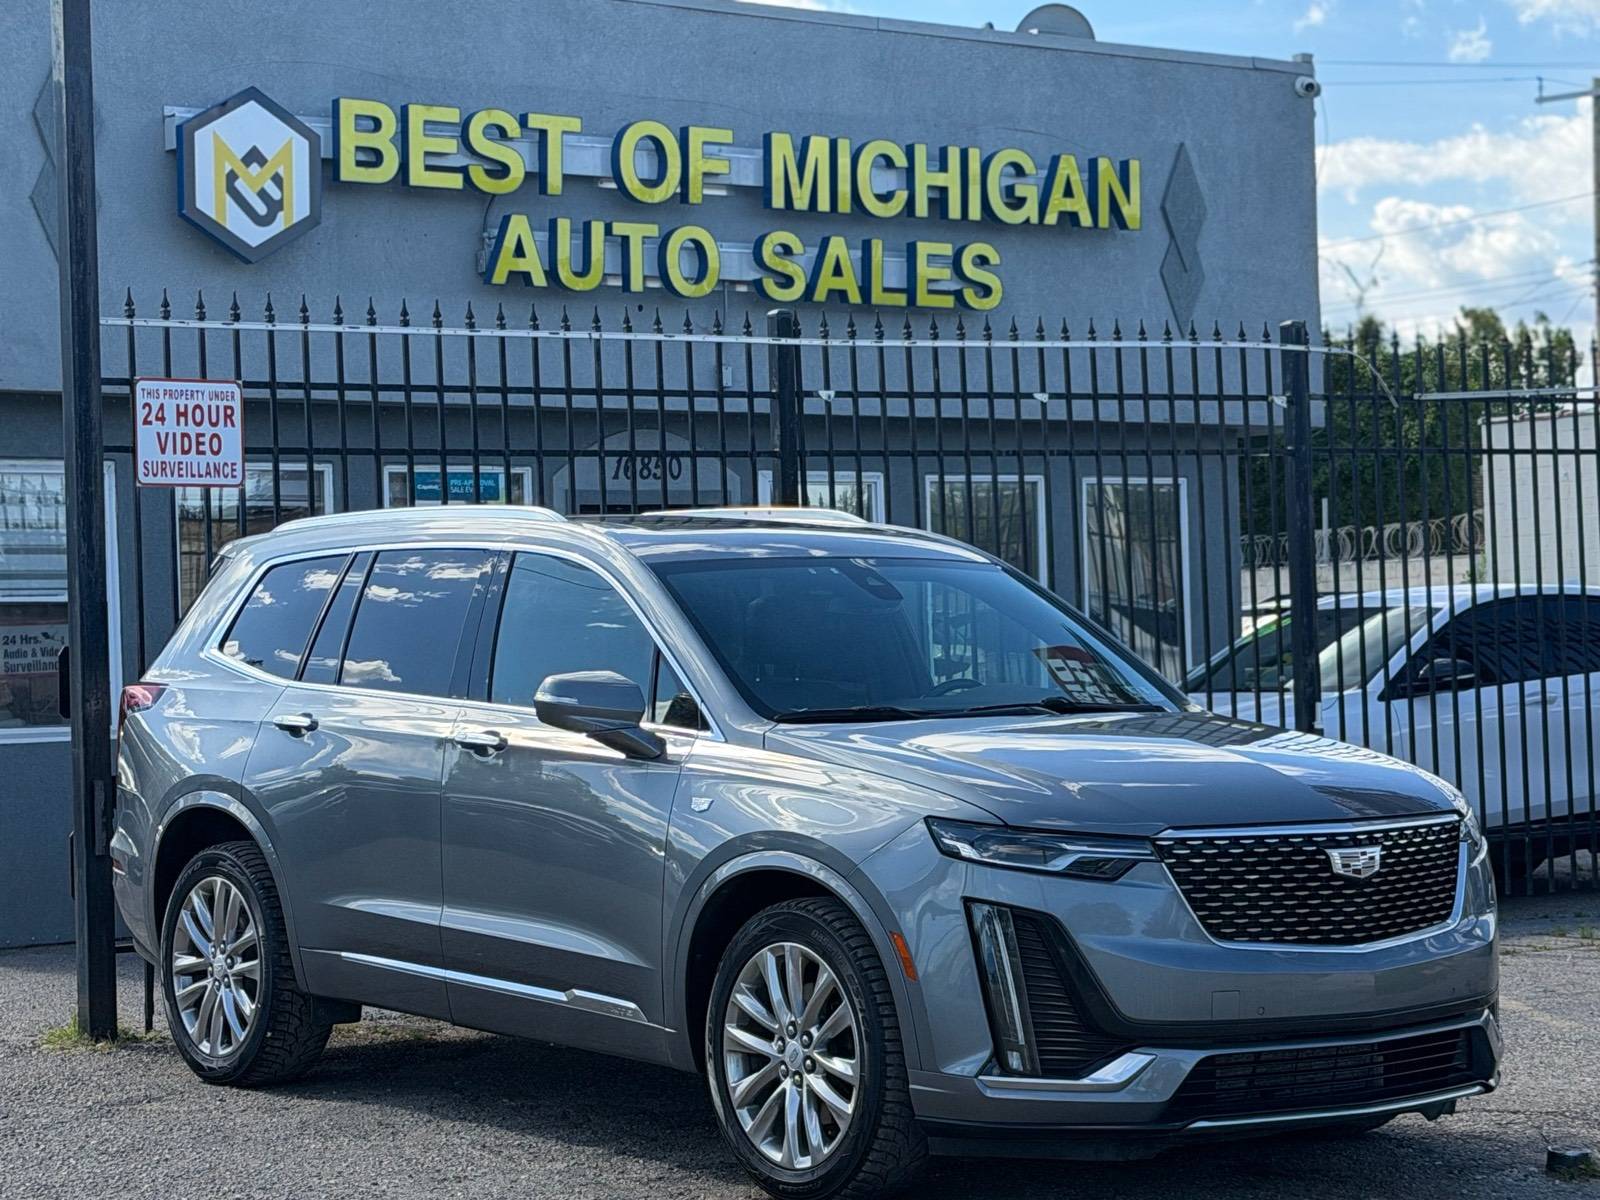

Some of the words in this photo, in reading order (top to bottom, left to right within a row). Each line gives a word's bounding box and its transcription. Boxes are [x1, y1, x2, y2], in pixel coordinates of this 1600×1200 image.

[332, 97, 582, 196] BEST
[611, 119, 734, 206] OF
[763, 131, 1142, 231] MICHIGAN
[485, 213, 722, 299] AUTO
[752, 230, 1004, 312] SALES
[141, 387, 160, 399] THIS
[163, 388, 206, 400] PROPERTY
[208, 390, 236, 402] UNDER
[142, 402, 167, 426] 24
[175, 403, 236, 428] HOUR
[156, 431, 222, 456] VIDEO
[143, 460, 238, 479] SURVEILLANCE
[2, 635, 17, 645] 24
[20, 634, 41, 644] Hrs.
[3, 648, 28, 659] Audio
[31, 647, 38, 657] &
